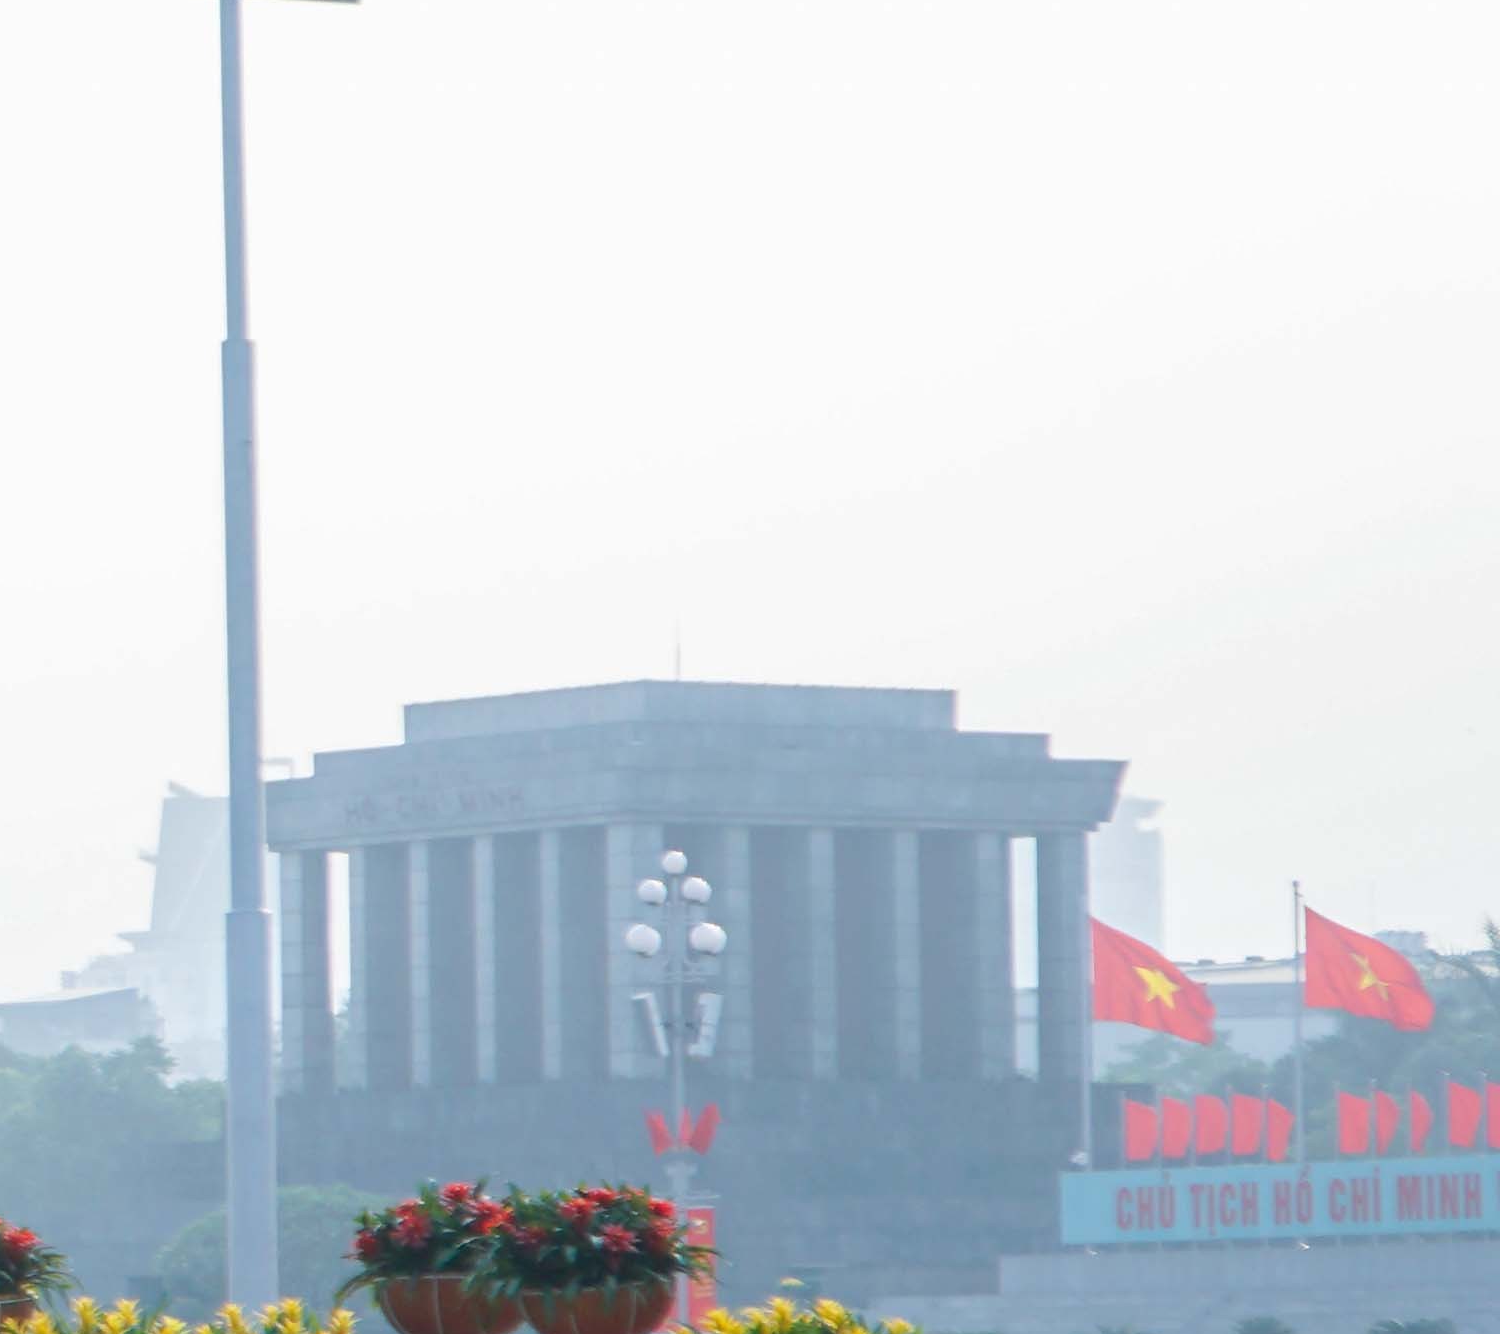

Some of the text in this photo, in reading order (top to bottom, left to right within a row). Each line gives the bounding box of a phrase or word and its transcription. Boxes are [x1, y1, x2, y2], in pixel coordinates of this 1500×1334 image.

[1114, 1171, 1175, 1231] CHỦ
[1188, 1181, 1260, 1236] TỊCH
[1271, 1163, 1315, 1226] HỒ
[1328, 1166, 1382, 1223] CHÍ
[1395, 1172, 1484, 1221] MINH
